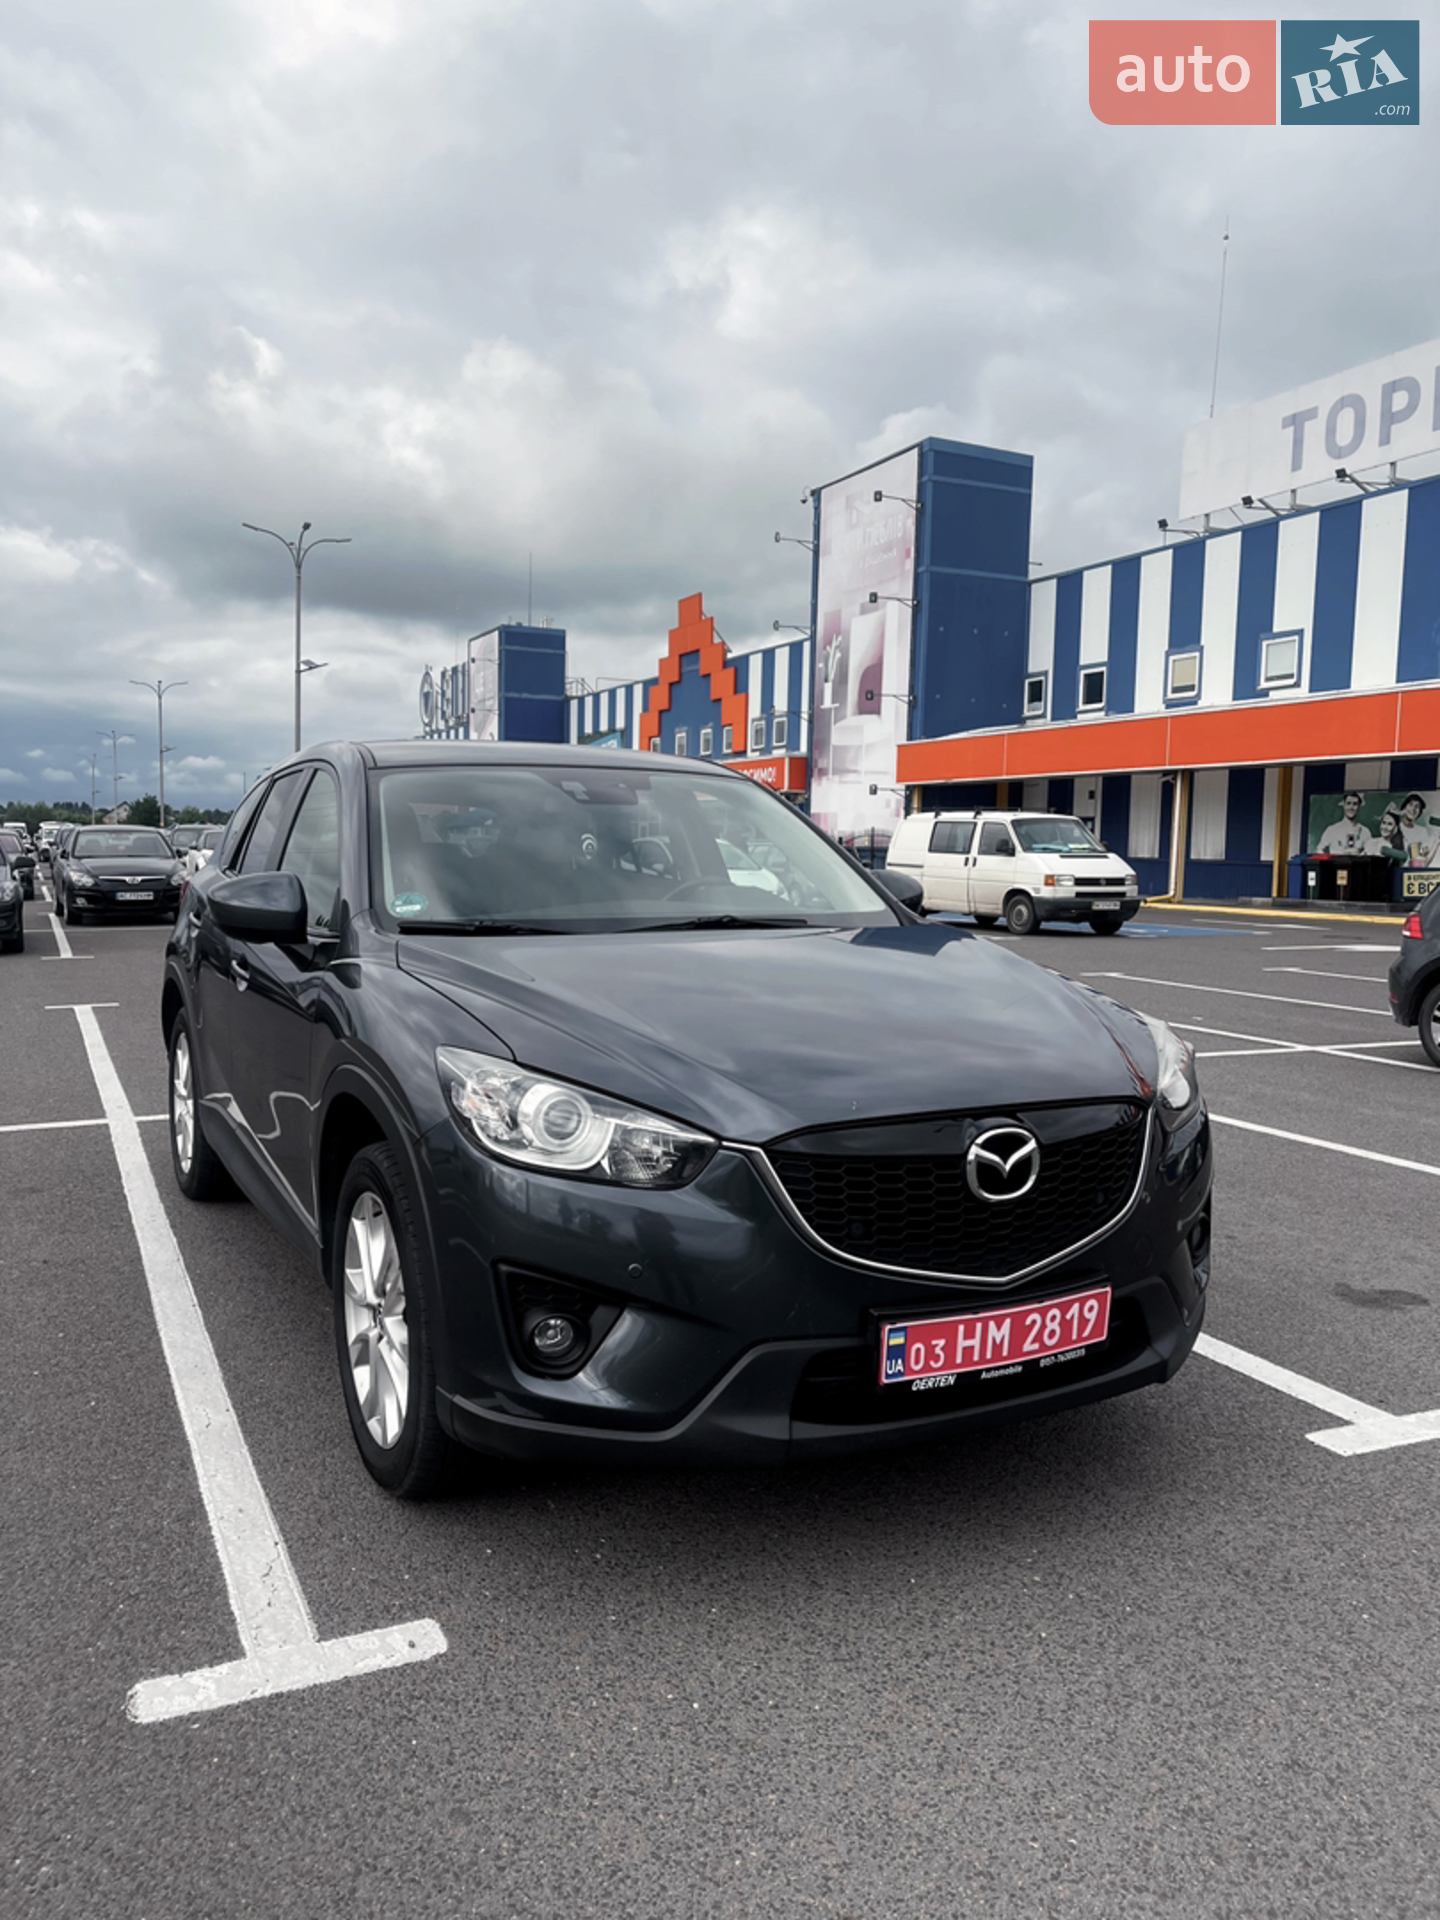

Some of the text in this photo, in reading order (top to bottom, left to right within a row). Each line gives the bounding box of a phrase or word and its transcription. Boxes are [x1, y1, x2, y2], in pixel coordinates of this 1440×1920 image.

[1418, 882, 1440, 894] ВС
[886, 1299, 1100, 1375] UA 03 HM 2819
